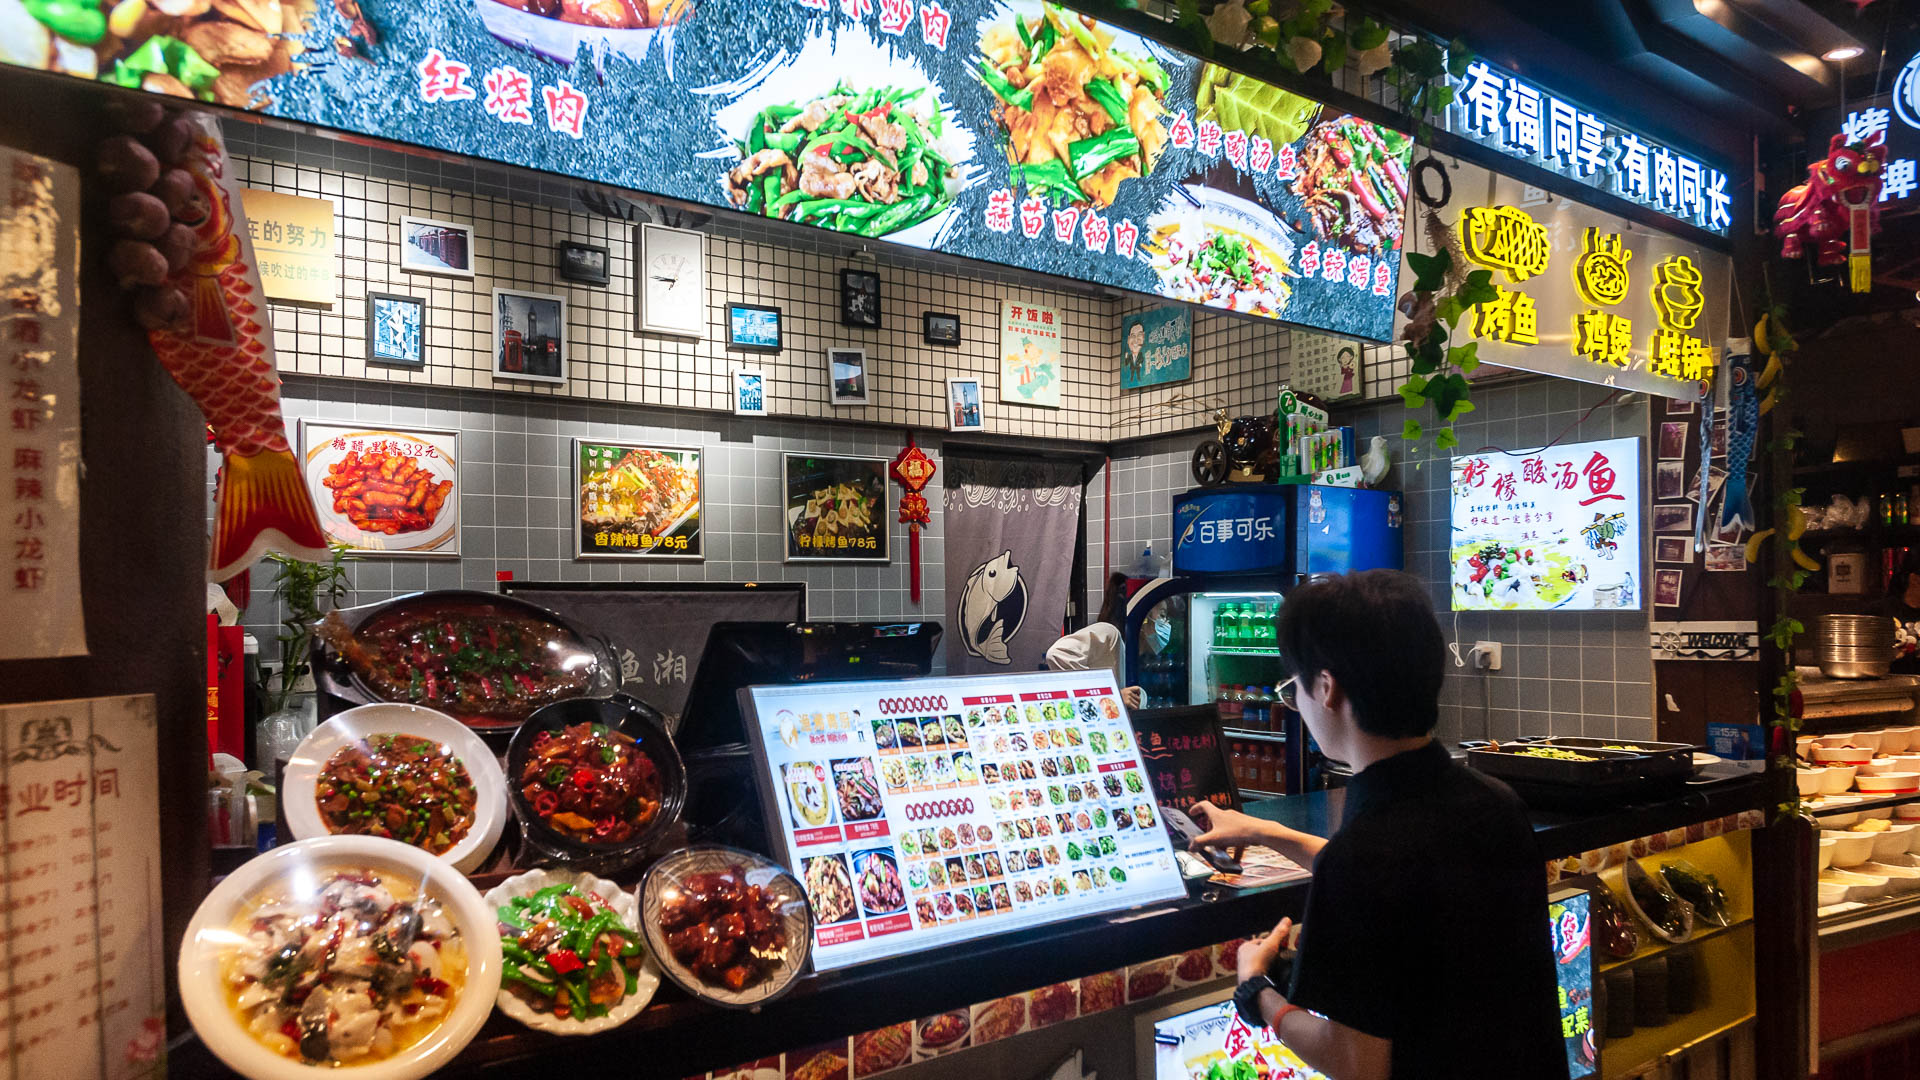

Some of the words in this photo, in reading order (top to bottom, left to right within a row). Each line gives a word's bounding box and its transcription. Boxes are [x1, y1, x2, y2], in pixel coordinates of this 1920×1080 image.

[420, 50, 587, 138] 红烧肉
[1170, 111, 1296, 179] 金牌酸汤鱼
[1465, 61, 1607, 176] 有福同享
[1620, 132, 1732, 228] 有肉同长
[986, 190, 1137, 258] 蒜苗回锅肉
[1301, 243, 1391, 294] 香辣烤鱼
[1011, 306, 1054, 325] 开饭啦
[1478, 285, 1539, 346] 烤鱼
[1576, 310, 1633, 367] 鸡煲
[1462, 451, 1626, 506] 柠檬酸汤鱼
[14, 448, 45, 590] 麻辣小龙虾
[595, 532, 688, 549] 香辣烤鱼78元
[800, 535, 877, 549] 柠檬烤鱼78元
[1199, 517, 1275, 544] 百事可乐
[1688, 633, 1749, 648] WELCOME
